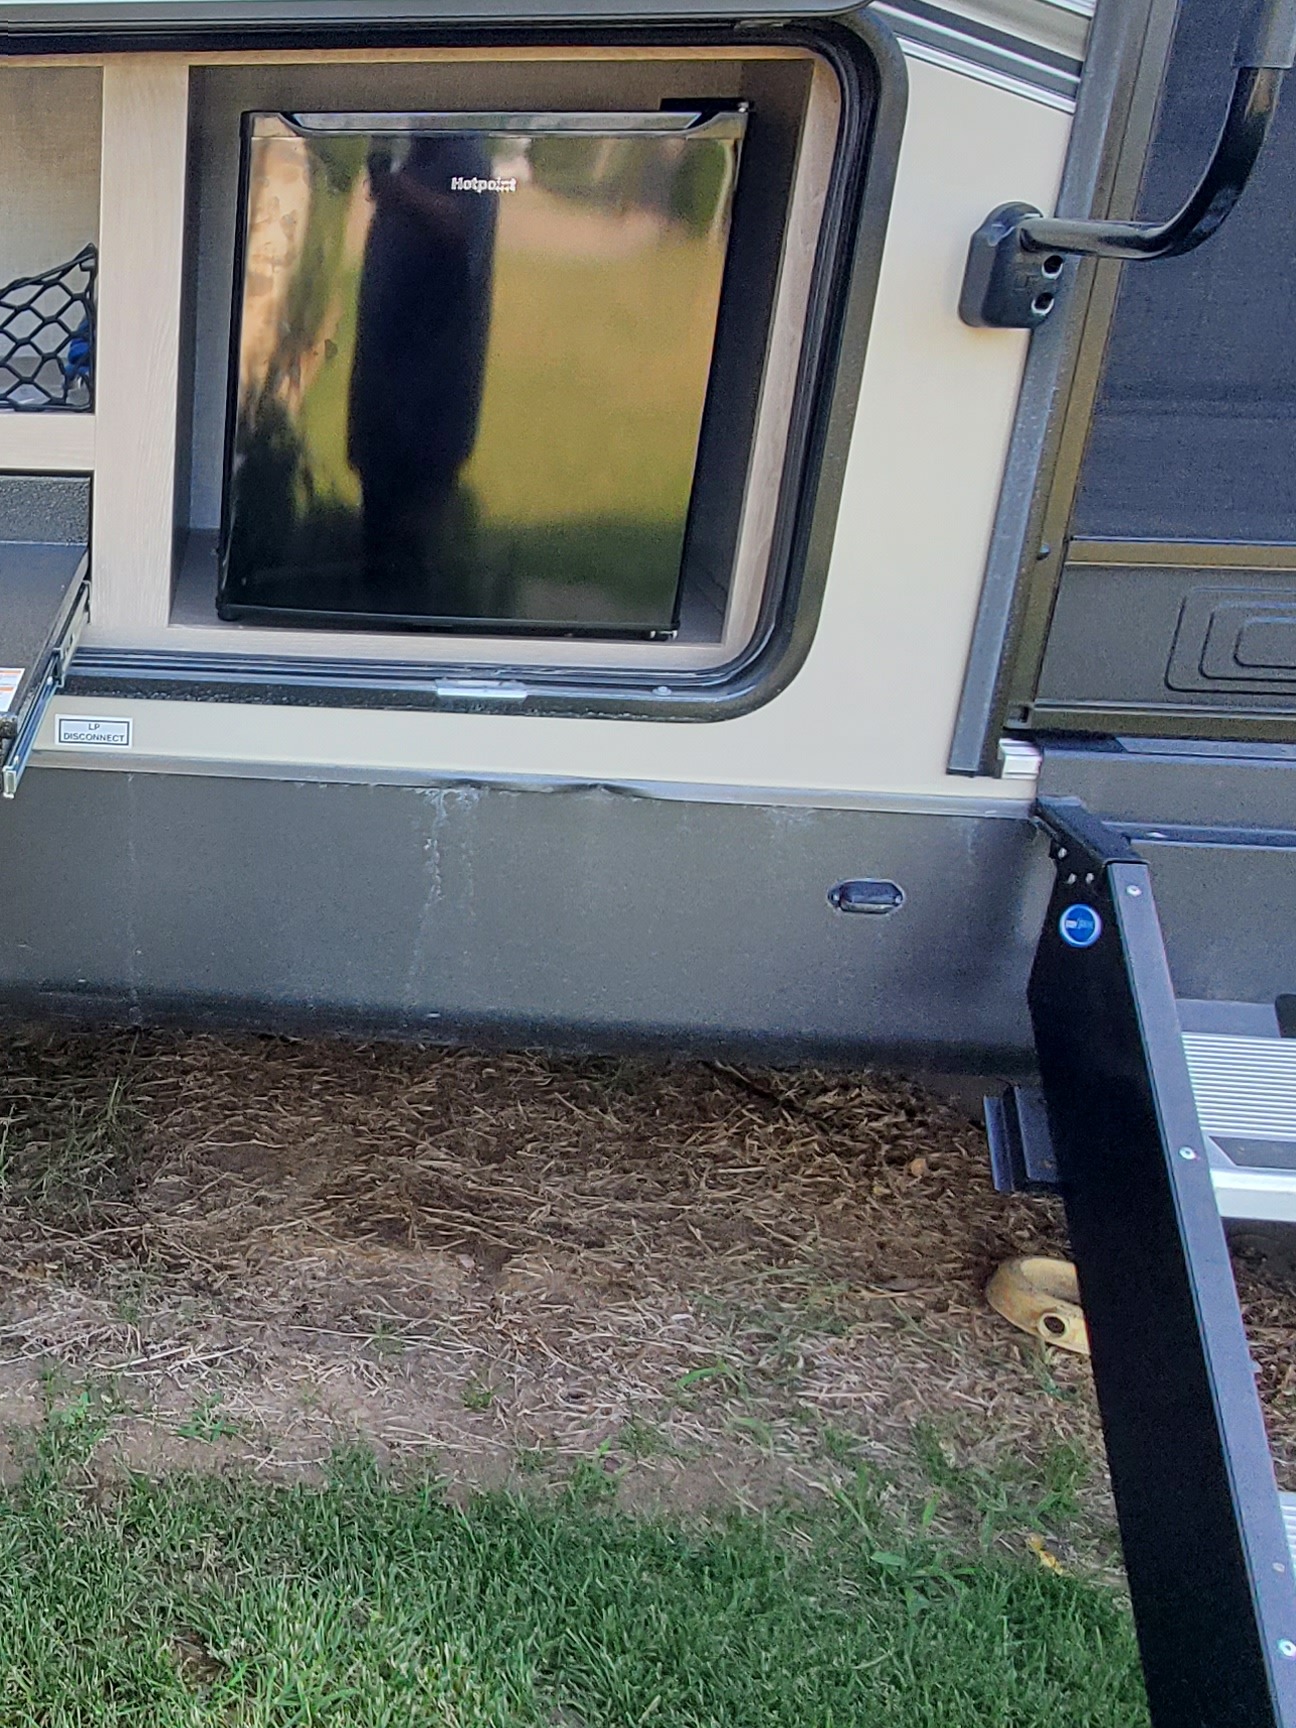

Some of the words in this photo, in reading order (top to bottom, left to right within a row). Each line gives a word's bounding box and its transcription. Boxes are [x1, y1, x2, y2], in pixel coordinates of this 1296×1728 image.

[451, 176, 516, 193] Hotpoint
[88, 723, 100, 731] LP
[63, 732, 125, 742] DISCONNECT
